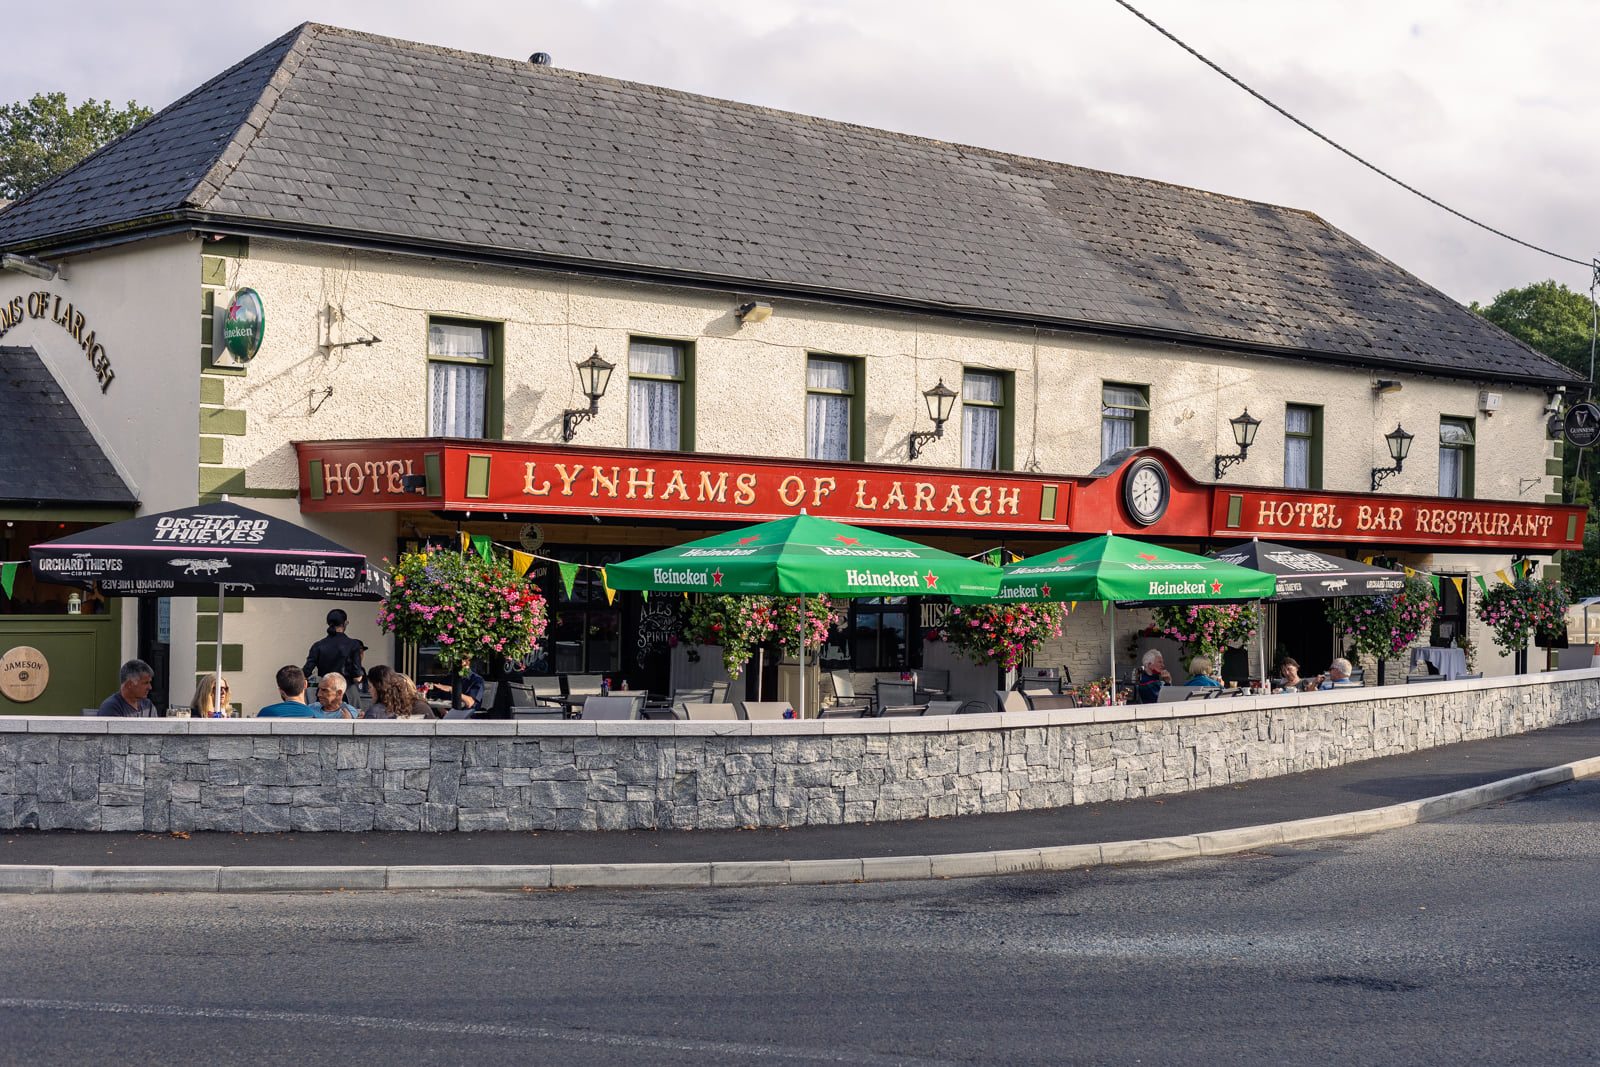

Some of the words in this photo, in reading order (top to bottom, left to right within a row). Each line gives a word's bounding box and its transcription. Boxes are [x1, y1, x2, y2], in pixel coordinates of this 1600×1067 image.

[224, 324, 254, 339] eineken
[0, 295, 24, 338] MS
[26, 291, 50, 319] OF
[51, 294, 115, 395] LARAGH
[522, 461, 757, 506] LYNHAMS
[778, 475, 836, 508] OF
[855, 479, 1021, 516] LARAGH
[156, 516, 269, 530] ORCHARD
[1258, 500, 1343, 530] HOTEL
[1357, 505, 1404, 531] BAR
[1415, 508, 1554, 538] RESTAURANT
[154, 527, 266, 541] THIEVES
[816, 546, 920, 559] Heineken
[39, 558, 84, 571] ORCHARD
[85, 558, 123, 571] THIEVES
[275, 563, 318, 578] ORCHARD
[319, 565, 356, 579] THIEVES
[653, 567, 708, 585] Heineken
[846, 569, 919, 587] Heineken
[991, 584, 1038, 599] eineken
[1148, 579, 1207, 595] Heineken
[640, 602, 672, 623] ALES
[4, 660, 43, 671] JAMESON
